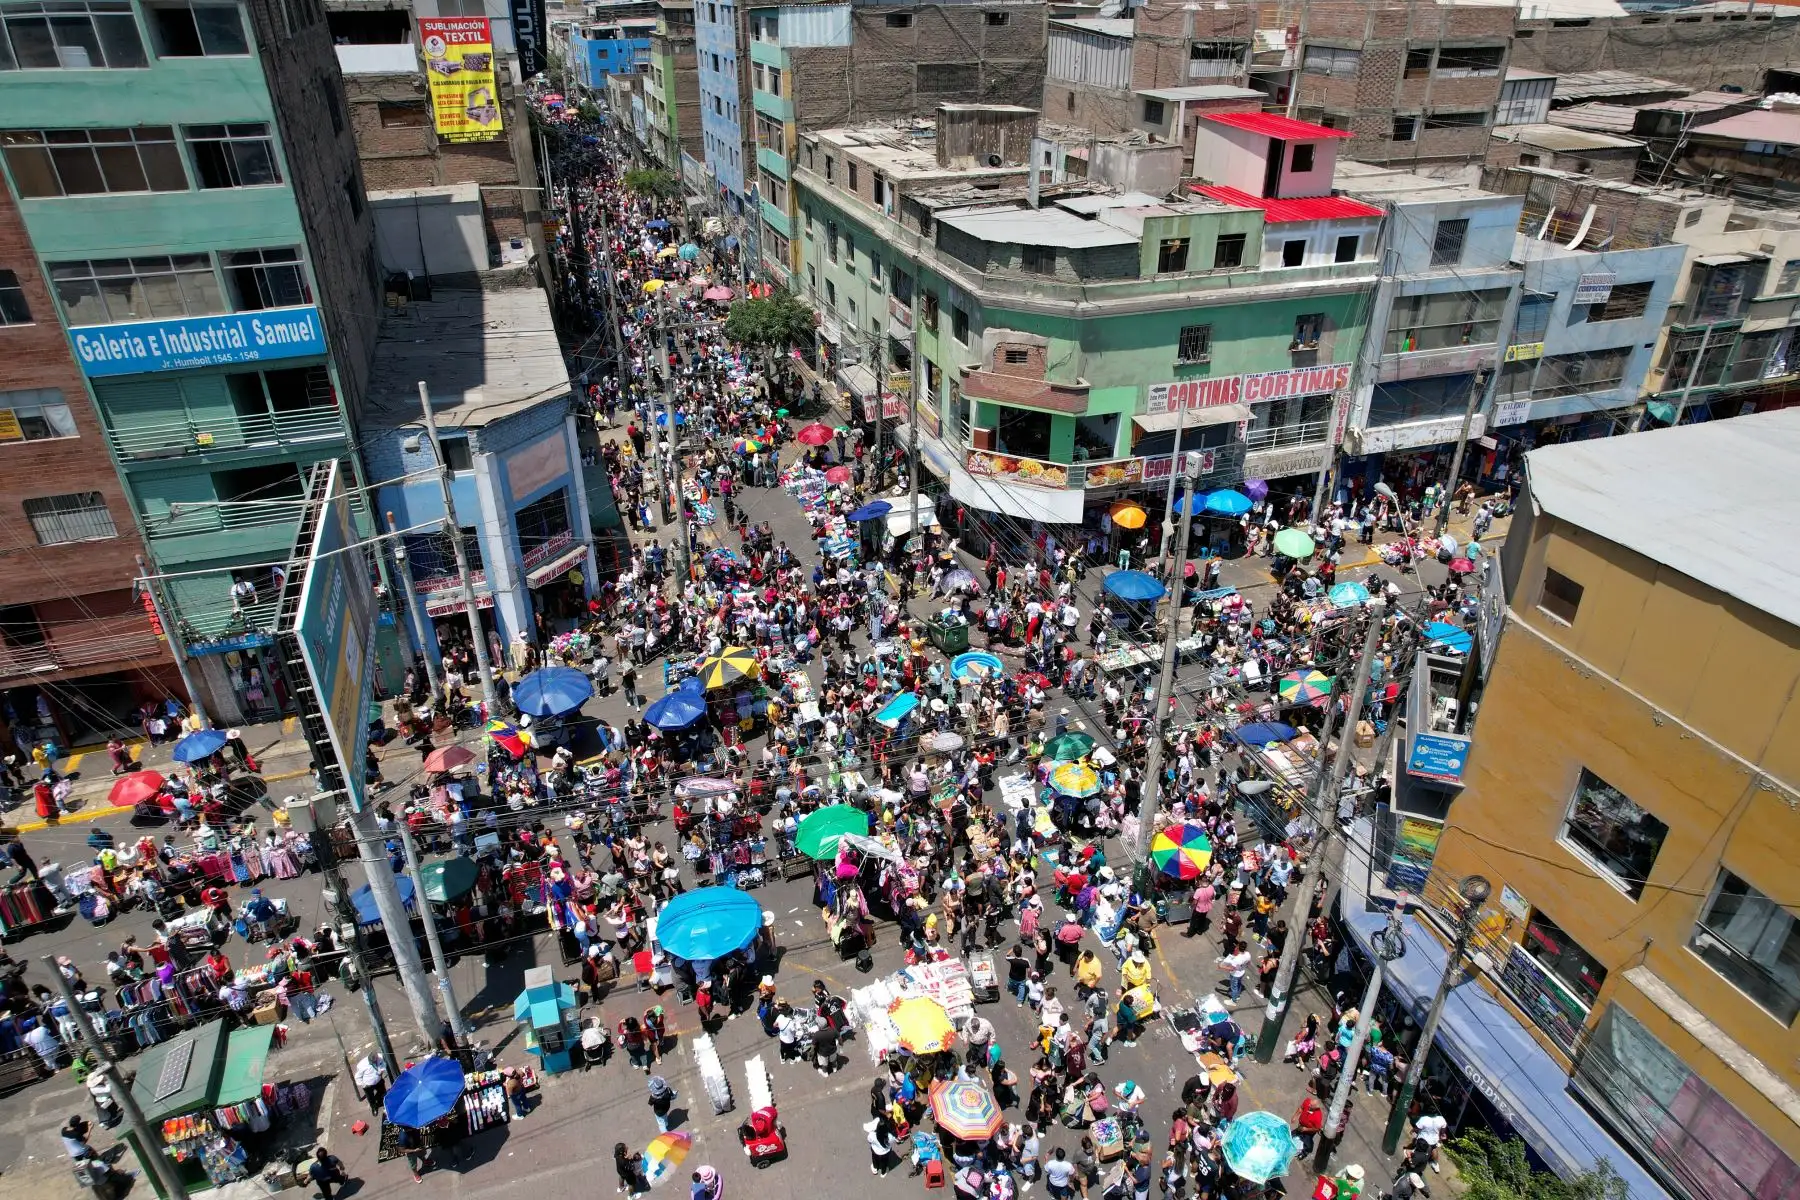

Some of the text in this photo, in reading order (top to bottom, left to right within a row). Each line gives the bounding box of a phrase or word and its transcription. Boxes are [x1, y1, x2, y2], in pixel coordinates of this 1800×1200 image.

[425, 20, 485, 30] SUBLIMACIÓN
[443, 31, 485, 42] TEXTIL
[76, 314, 316, 362] Galeria E Industrial Samuel
[162, 359, 173, 368] Jr.
[212, 353, 233, 364] 1545
[239, 350, 259, 361] 1549
[1167, 377, 1240, 412] CORTINAS
[1245, 368, 1349, 400] CORTINAS
[326, 601, 337, 643] SAN
[332, 568, 341, 610] LUIS
[1464, 1065, 1515, 1122] GOLDTEX
